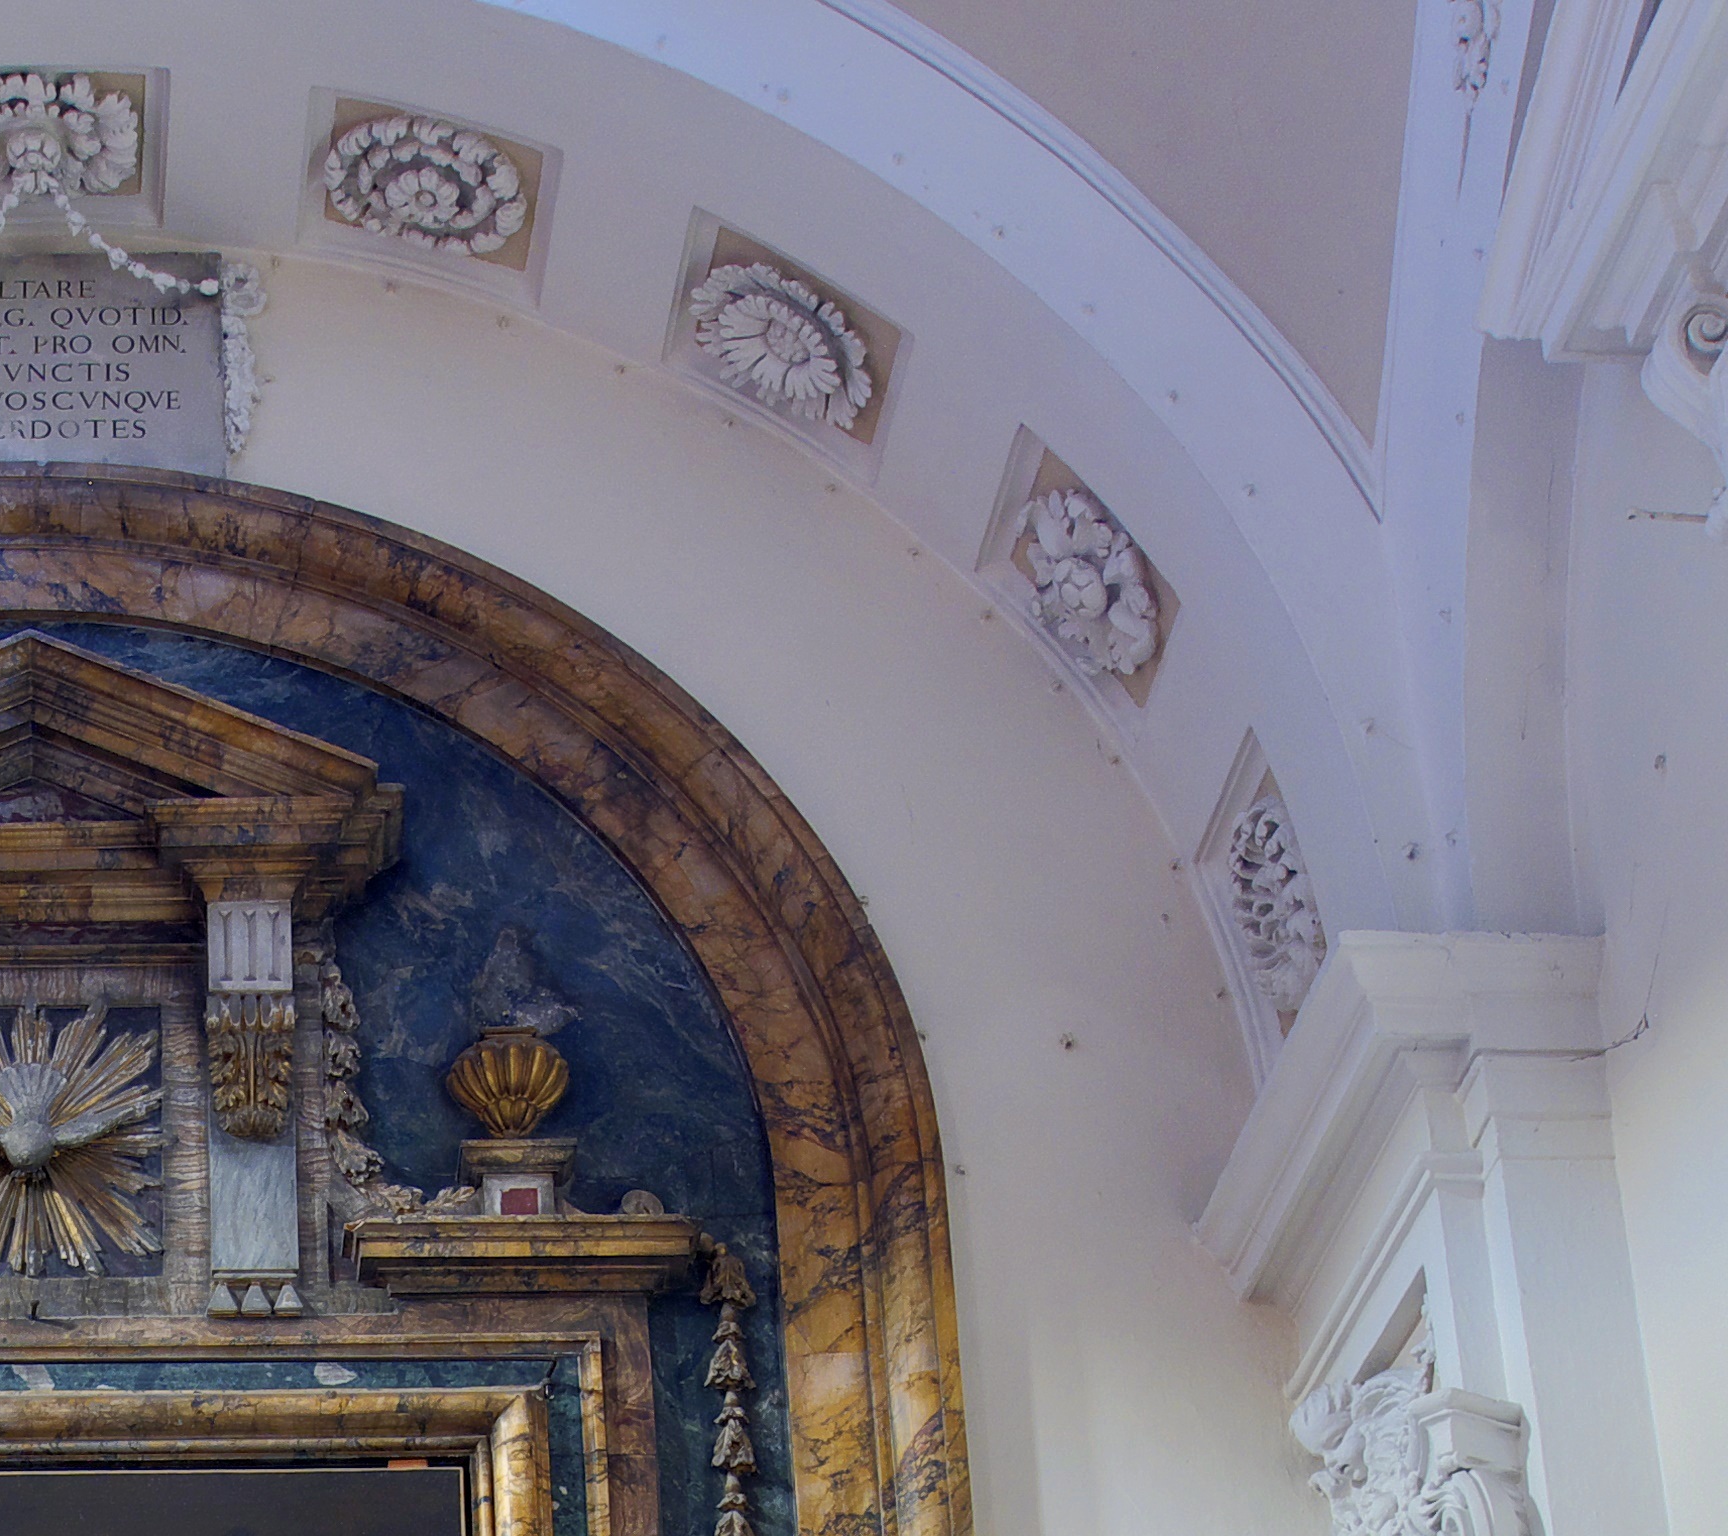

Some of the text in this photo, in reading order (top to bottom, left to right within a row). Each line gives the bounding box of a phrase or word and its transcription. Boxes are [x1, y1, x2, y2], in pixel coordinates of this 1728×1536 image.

[50, 307, 189, 329] QVOTID.
[33, 335, 92, 355] PRO
[112, 335, 187, 354] OMN.
